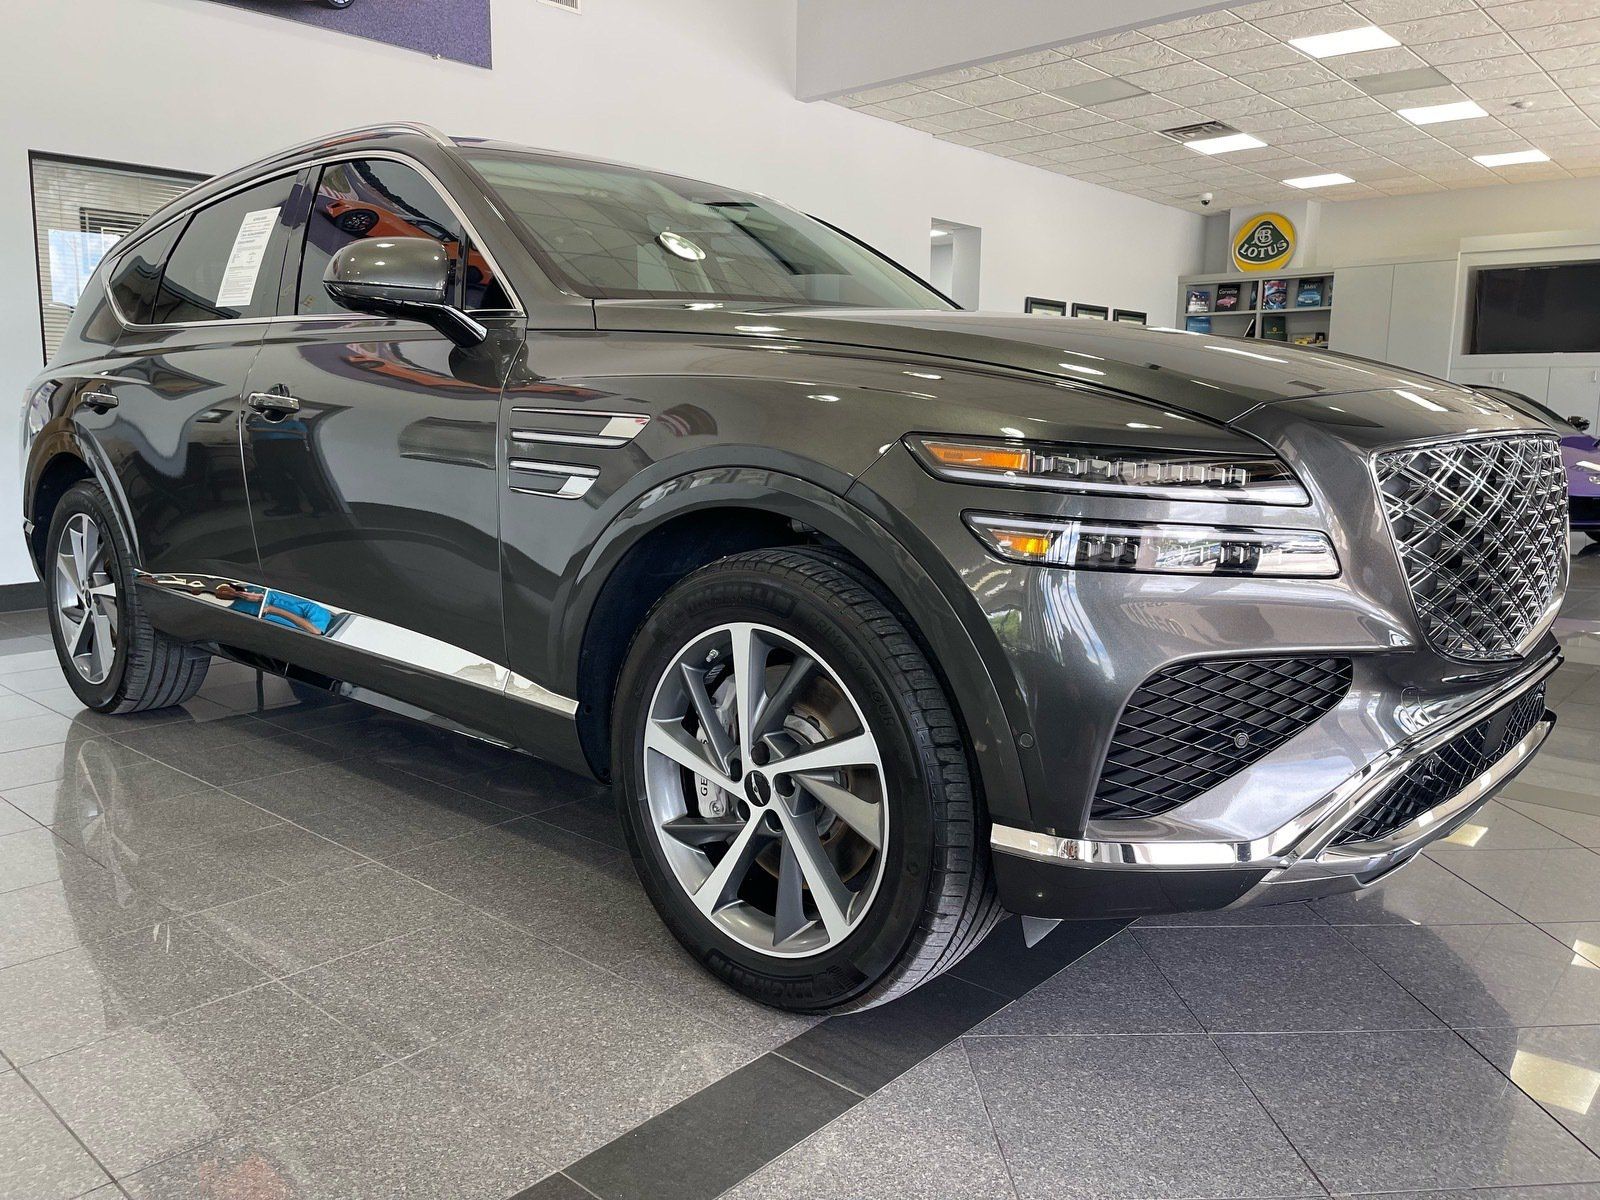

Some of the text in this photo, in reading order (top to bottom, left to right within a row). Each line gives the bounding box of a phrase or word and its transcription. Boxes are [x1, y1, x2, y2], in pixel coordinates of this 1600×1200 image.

[1240, 240, 1287, 258] LOTUS
[1218, 288, 1238, 296] Corvette
[865, 678, 895, 727] TOUR
